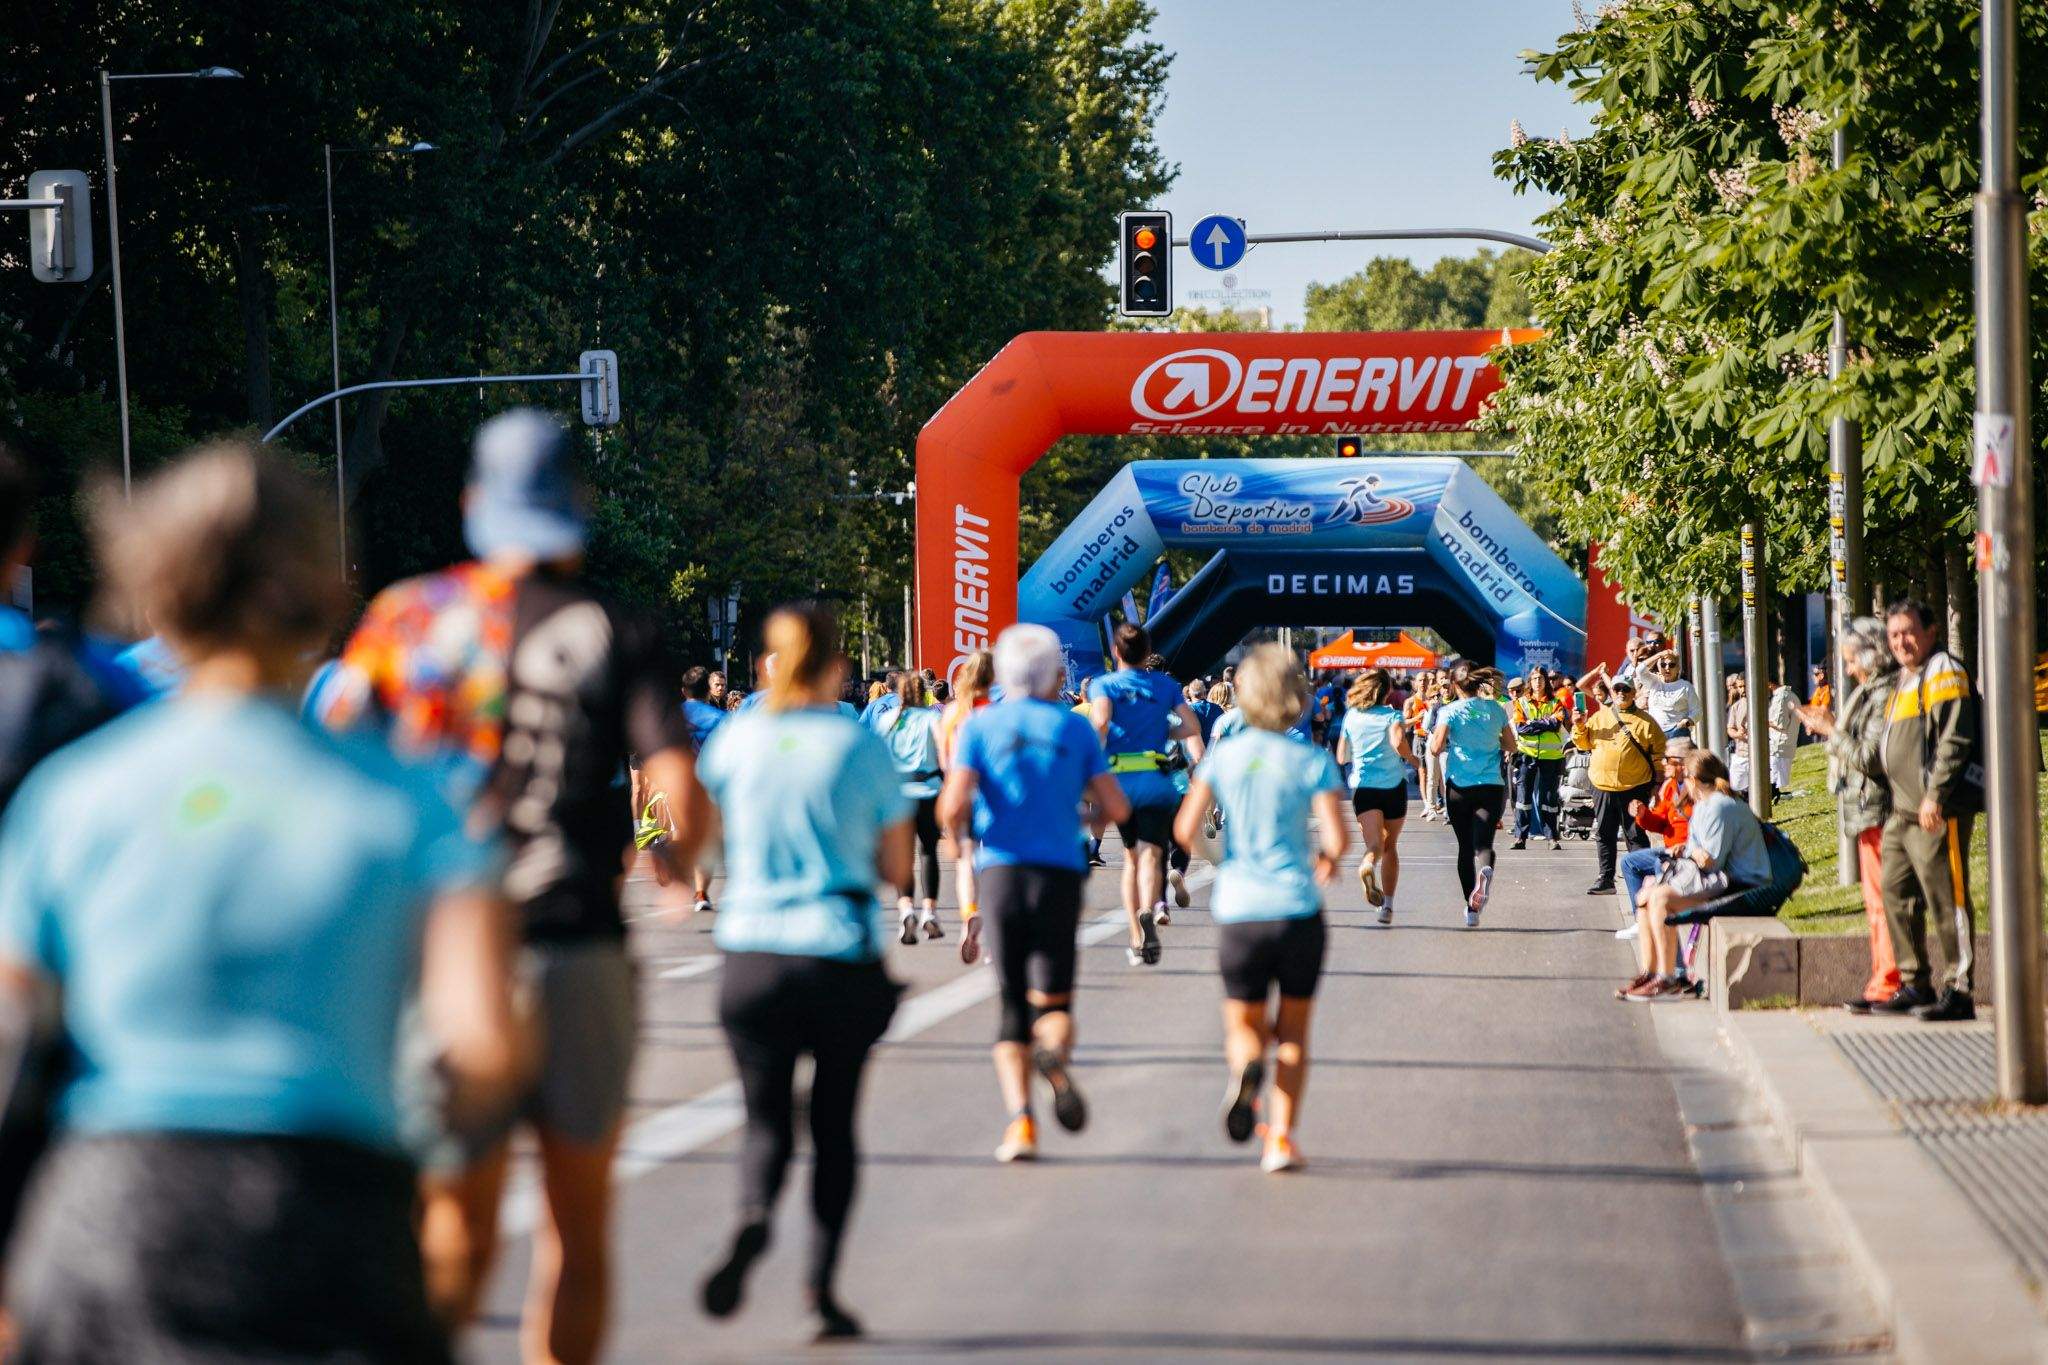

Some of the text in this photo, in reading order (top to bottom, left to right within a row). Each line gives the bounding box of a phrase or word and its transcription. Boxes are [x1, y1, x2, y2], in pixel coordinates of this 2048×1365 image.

[1236, 356, 1490, 413] ENERVIT
[1129, 422, 1264, 434] Science
[1277, 422, 1308, 434] in
[1183, 474, 1238, 494] Club
[1194, 493, 1312, 524] Deportivo
[1049, 505, 1135, 596] bomberos
[1183, 523, 1312, 533] bomberos de madrid
[1458, 510, 1545, 600] bomberos
[954, 504, 990, 653] ENERVIT
[1072, 534, 1140, 612] madrid
[1268, 574, 1414, 594] DECIMAS
[1440, 532, 1514, 603] madrid
